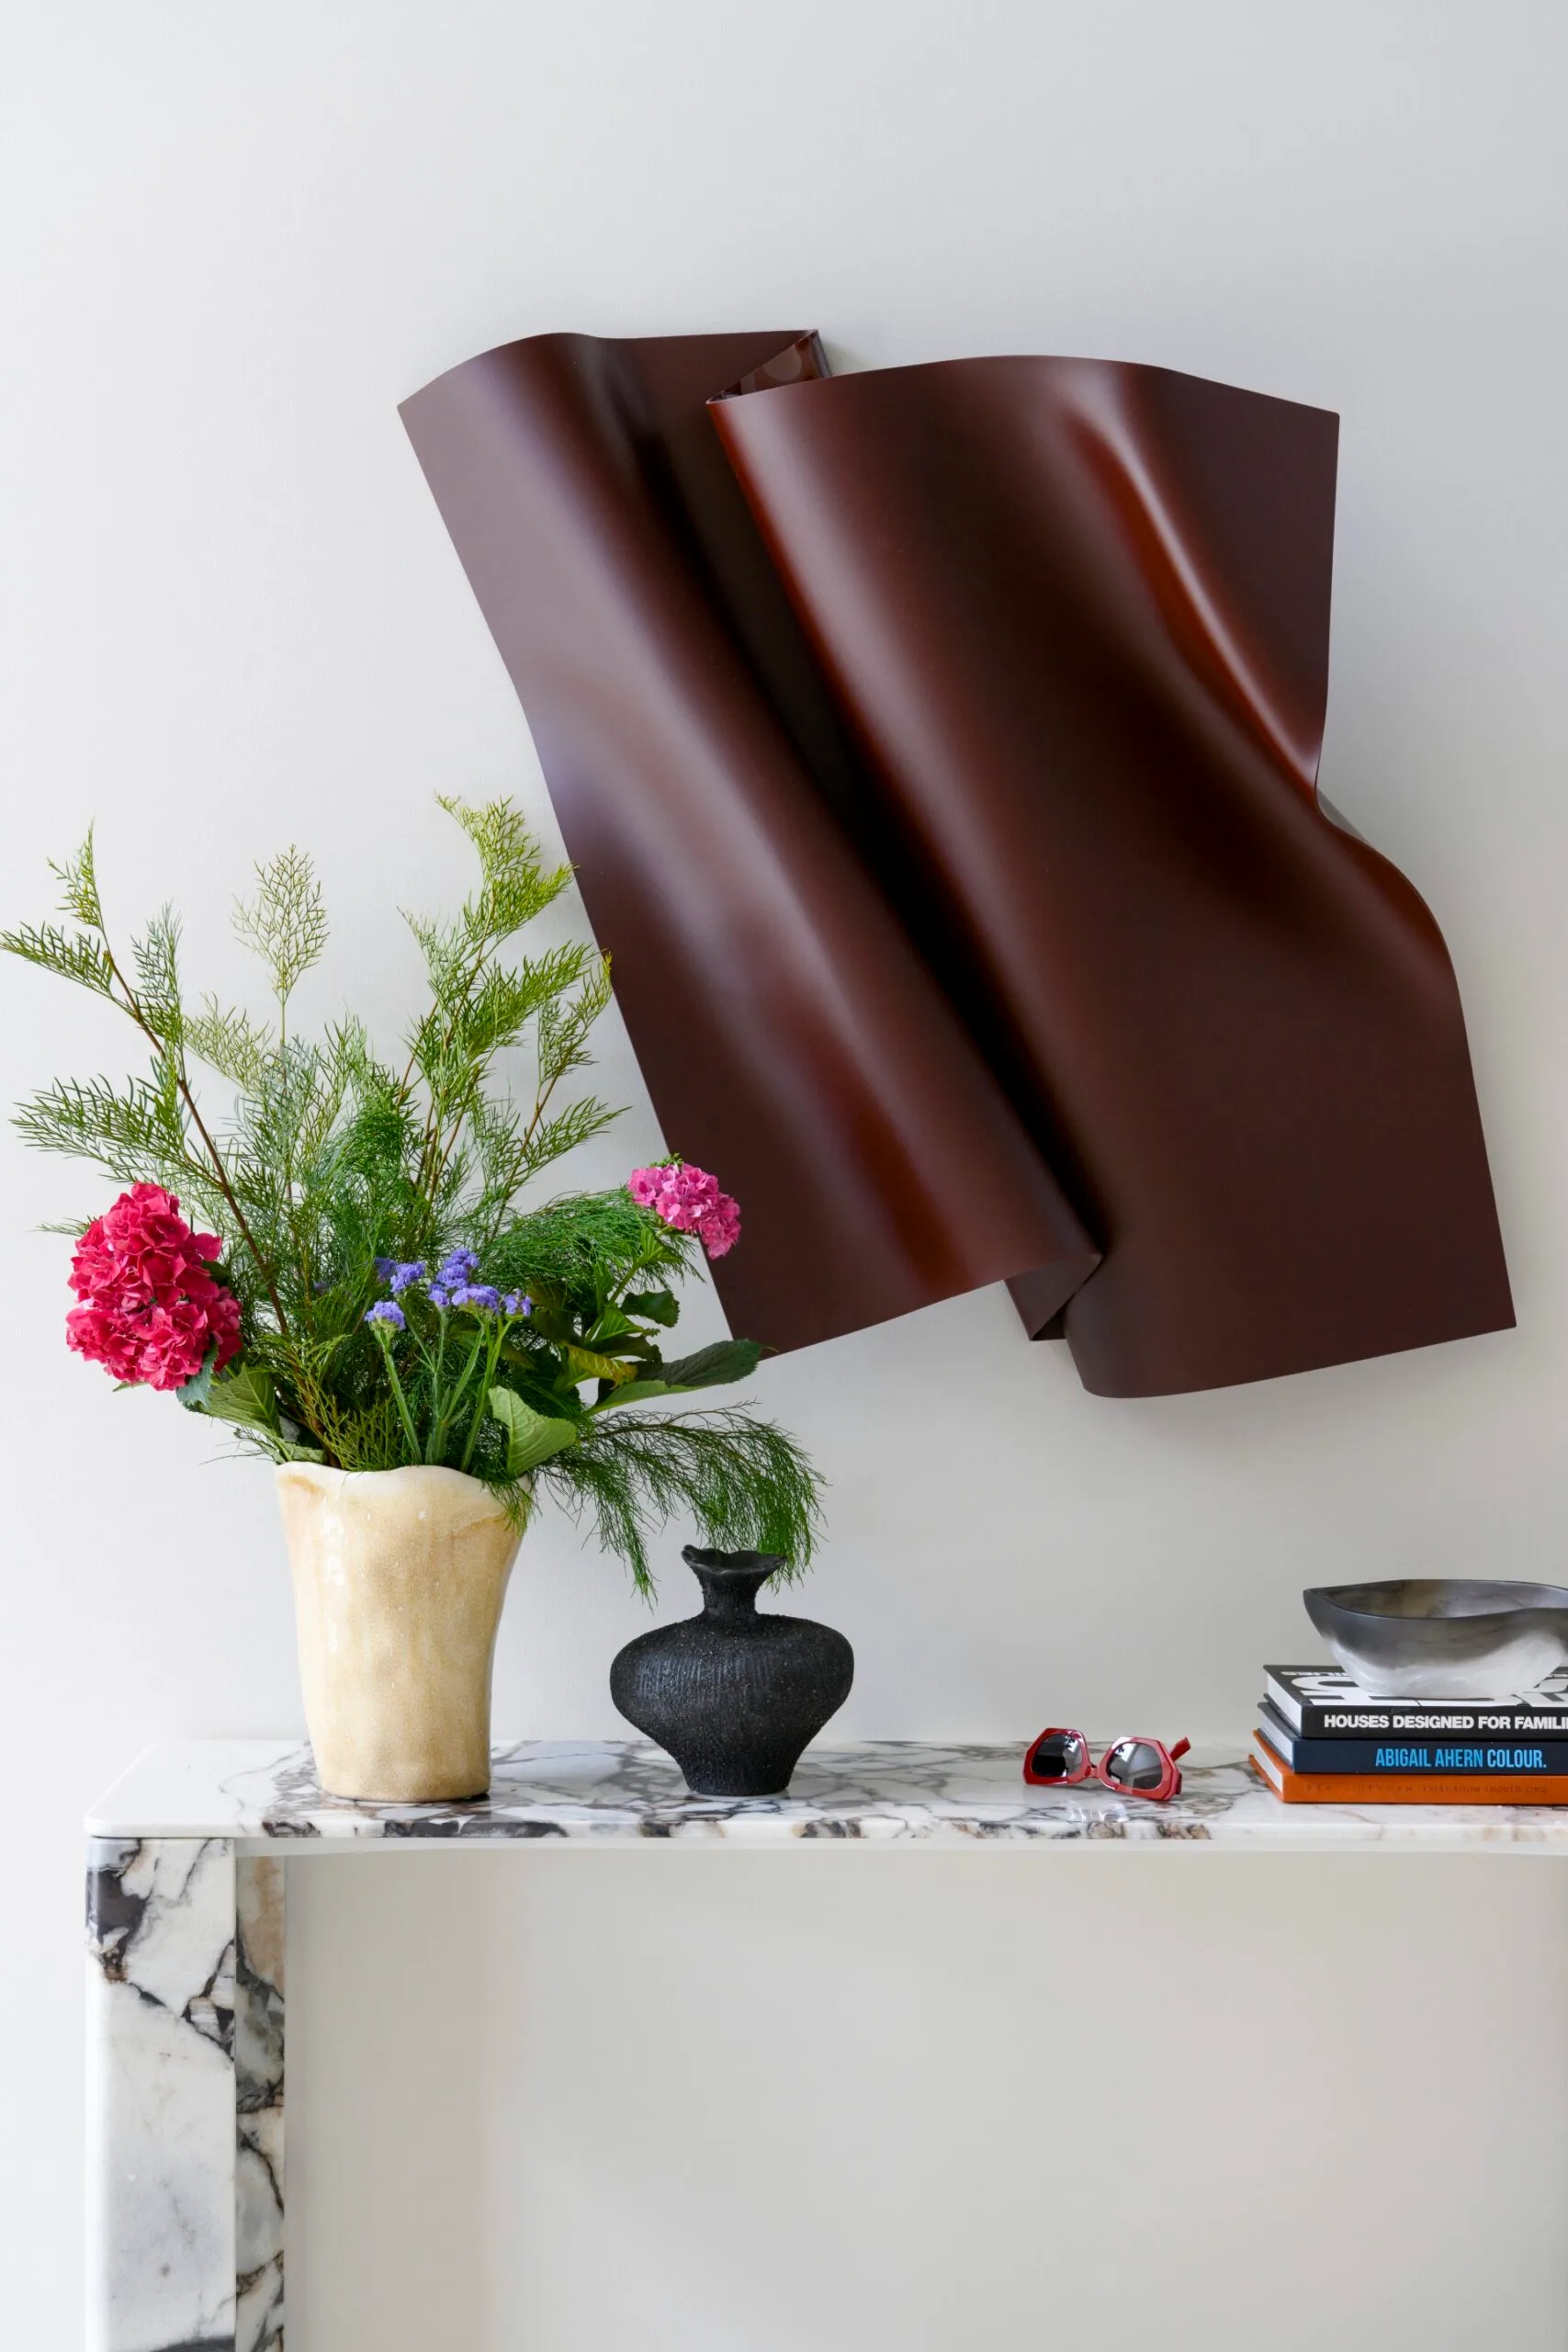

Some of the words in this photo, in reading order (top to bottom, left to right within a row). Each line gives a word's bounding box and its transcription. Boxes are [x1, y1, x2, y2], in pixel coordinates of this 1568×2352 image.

[1324, 1714, 1389, 1729] HOUSES
[1393, 1714, 1473, 1730] DESIGNED
[1478, 1715, 1511, 1730] FOR
[1375, 1748, 1431, 1768] ABIGAIL
[1435, 1748, 1483, 1768] AHERN
[1487, 1749, 1548, 1769] COLOUR.
